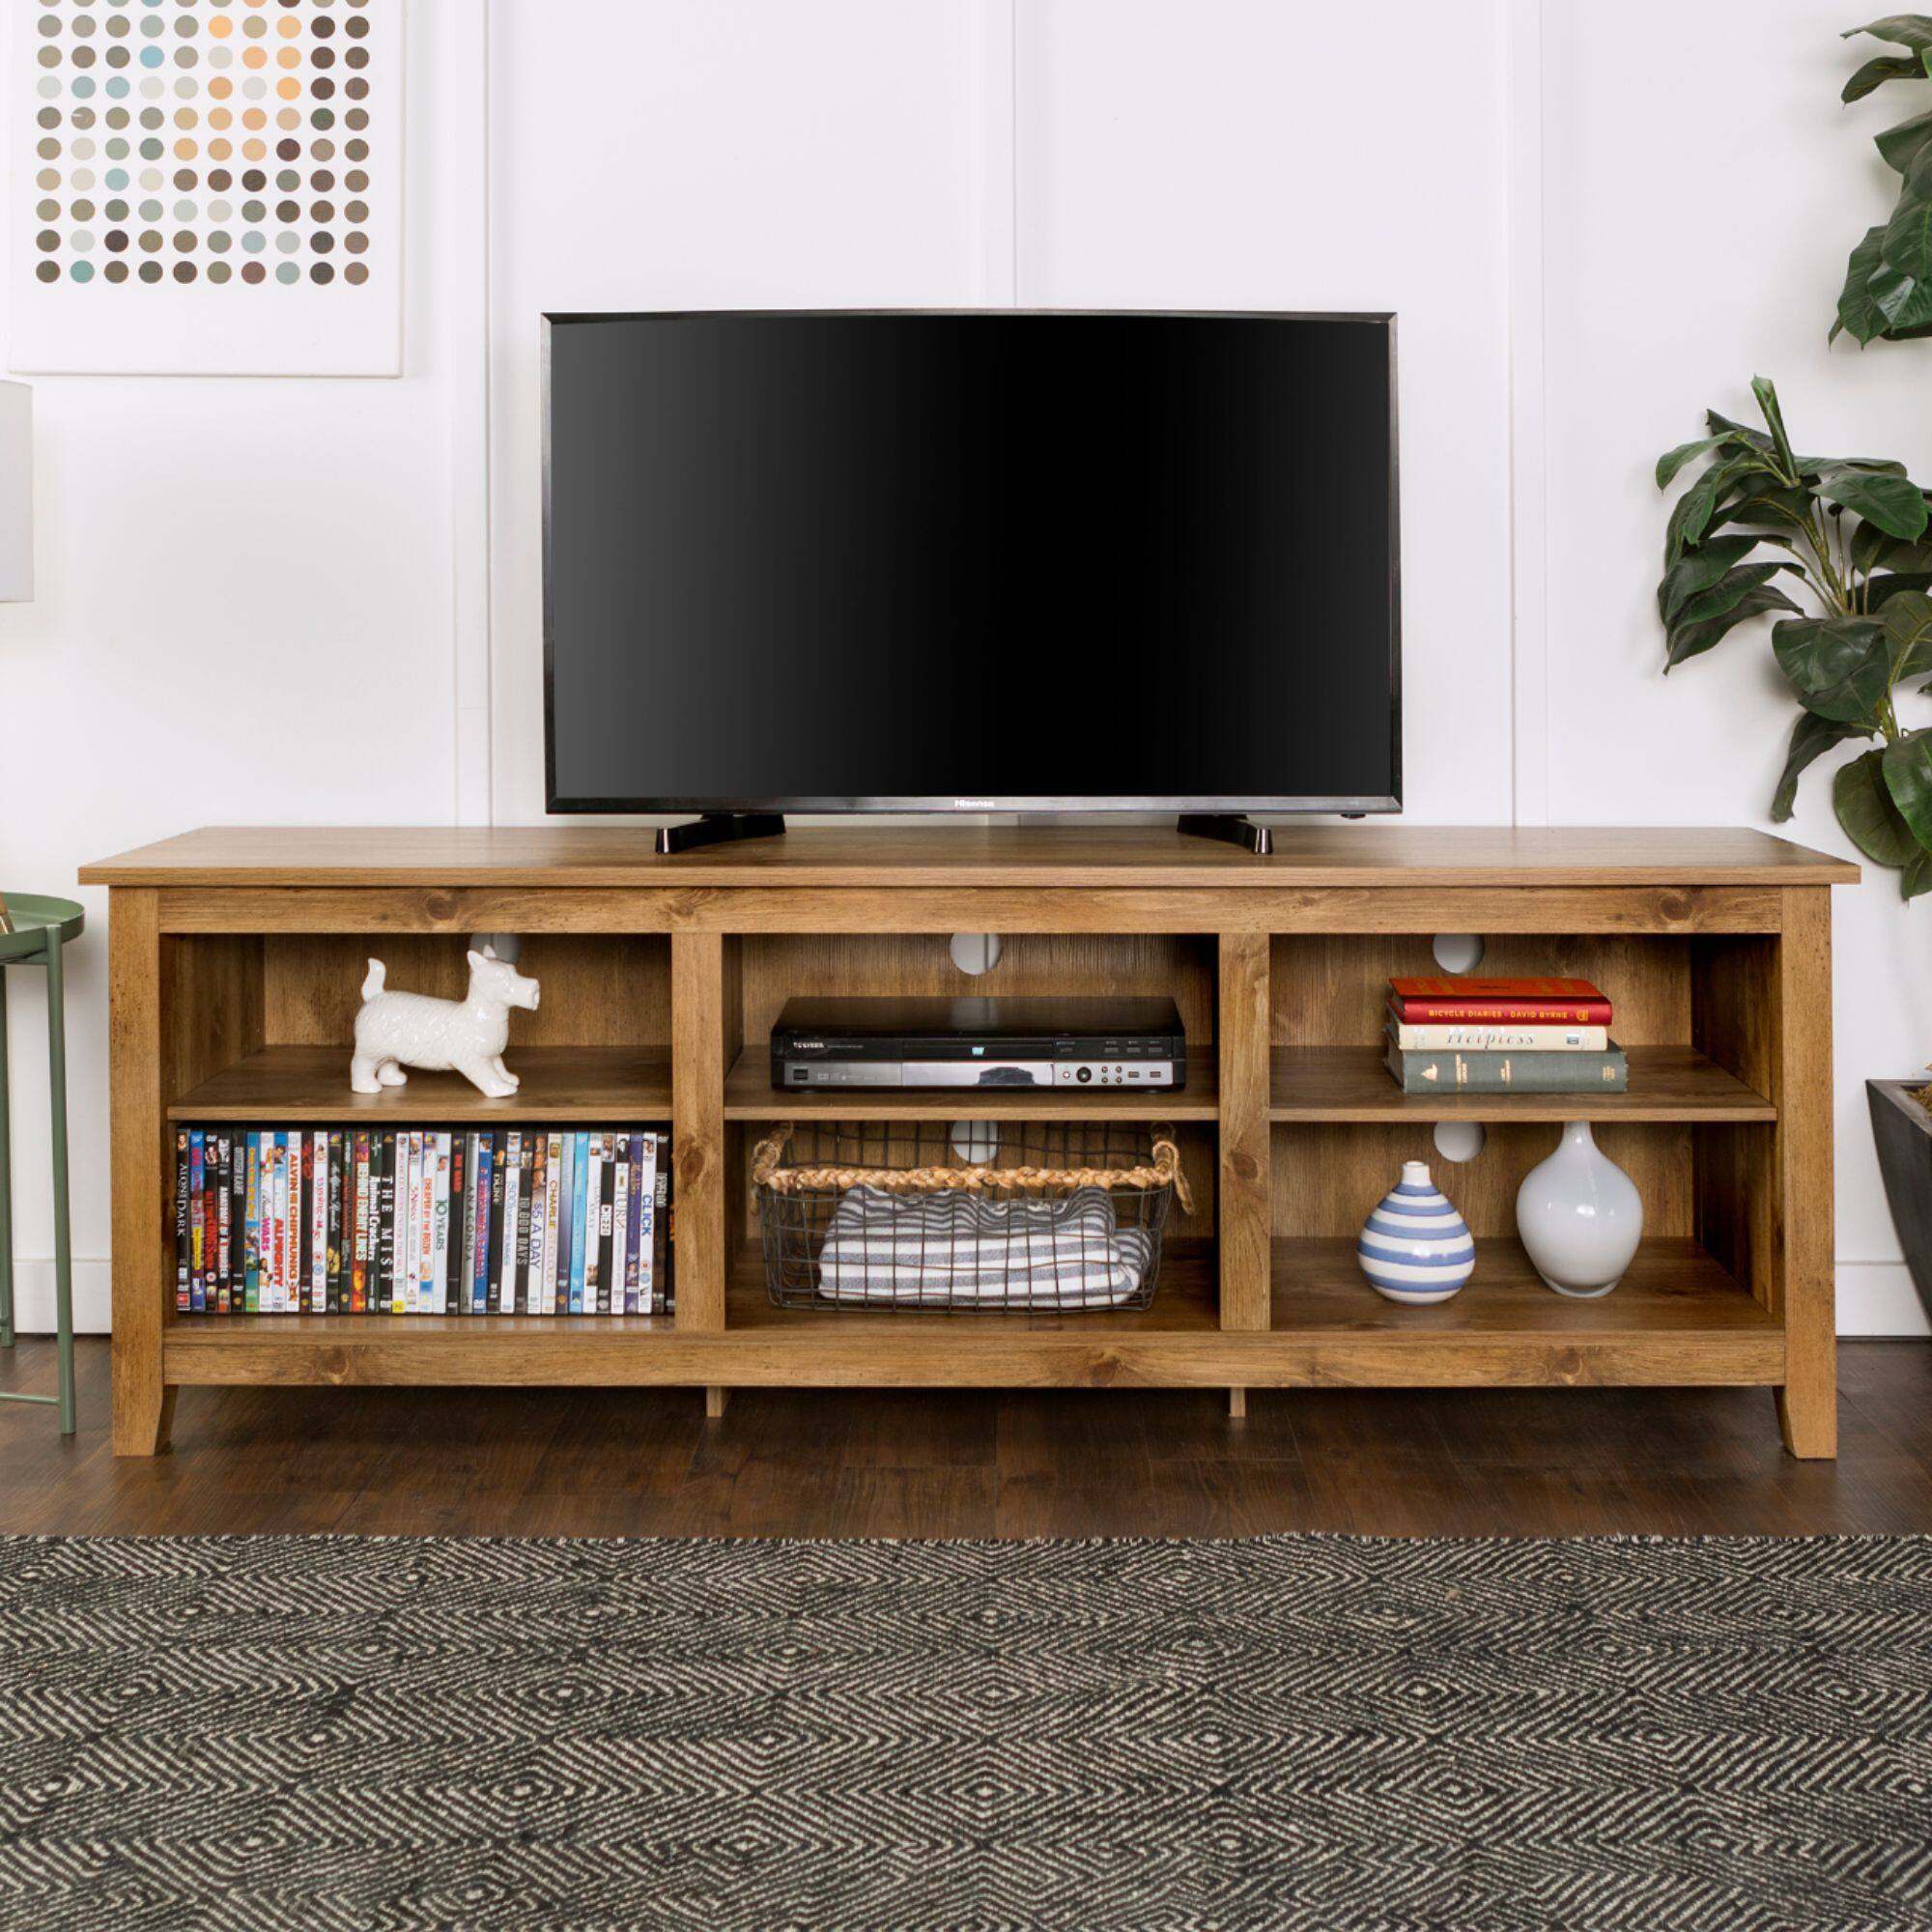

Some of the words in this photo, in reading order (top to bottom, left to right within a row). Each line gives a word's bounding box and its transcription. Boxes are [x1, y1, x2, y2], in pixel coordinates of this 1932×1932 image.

[954, 799, 995, 808] Hisense
[179, 1163, 188, 1200] ALONE
[289, 1154, 298, 1191] ALVIN
[357, 1162, 369, 1197] BEHIND
[218, 1186, 229, 1224] ANATOMY
[368, 1176, 382, 1214] Animal
[382, 1176, 393, 1212] THE
[423, 1178, 433, 1209] CHEAPER
[436, 1199, 448, 1216] 10
[548, 1179, 558, 1230] CHARLIE
[177, 1199, 187, 1236] DARK
[356, 1199, 369, 1233] ENEMY
[465, 1184, 474, 1262] ANACONDA
[531, 1222, 542, 1234] A
[640, 1194, 653, 1236] CLICK
[261, 1217, 271, 1251] WARS
[289, 1206, 298, 1280] CHIPMUNKS
[355, 1233, 368, 1262] LINES
[367, 1216, 381, 1262] Crackers
[422, 1233, 432, 1256] DOZEN
[435, 1218, 445, 1251] YEARS
[517, 1237, 530, 1266] DAYS
[274, 1218, 285, 1287] ALMIGHTY
[380, 1228, 393, 1281] MIST
[529, 1238, 542, 1269] DAY
[546, 1246, 555, 1284] CLOUD
